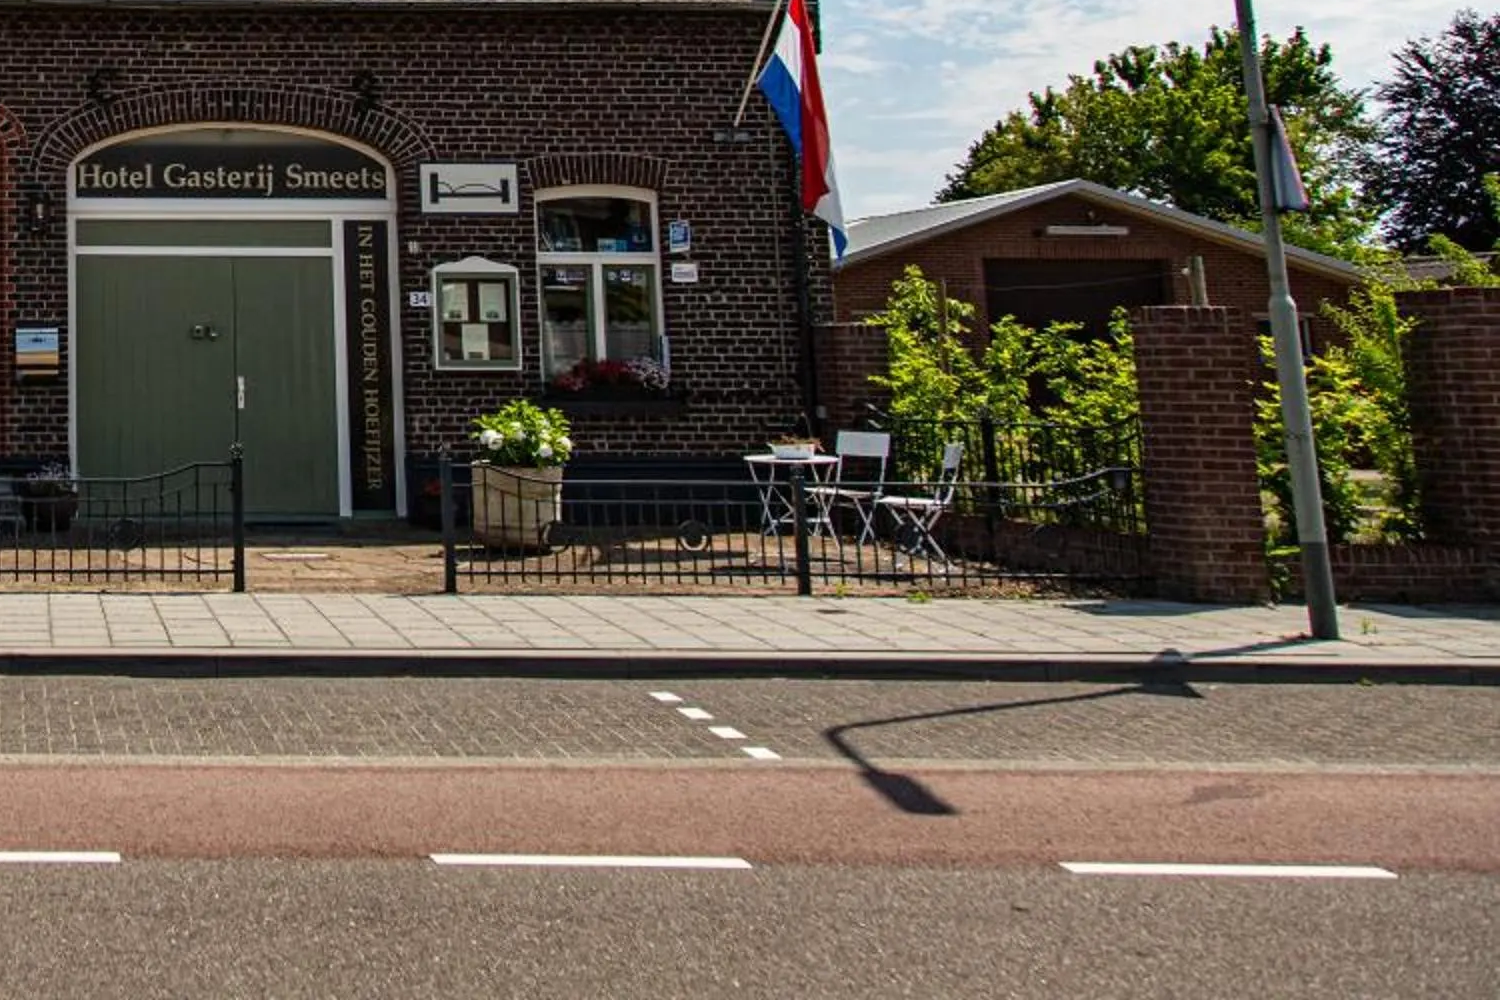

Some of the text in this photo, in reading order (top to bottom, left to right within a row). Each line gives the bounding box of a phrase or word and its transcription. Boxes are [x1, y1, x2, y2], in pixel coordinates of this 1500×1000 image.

[78, 162, 386, 197] Hotel Gasterij Smeets
[411, 292, 428, 306] 34
[357, 225, 384, 490] IN HET GOUDEN HOEFIJZER
